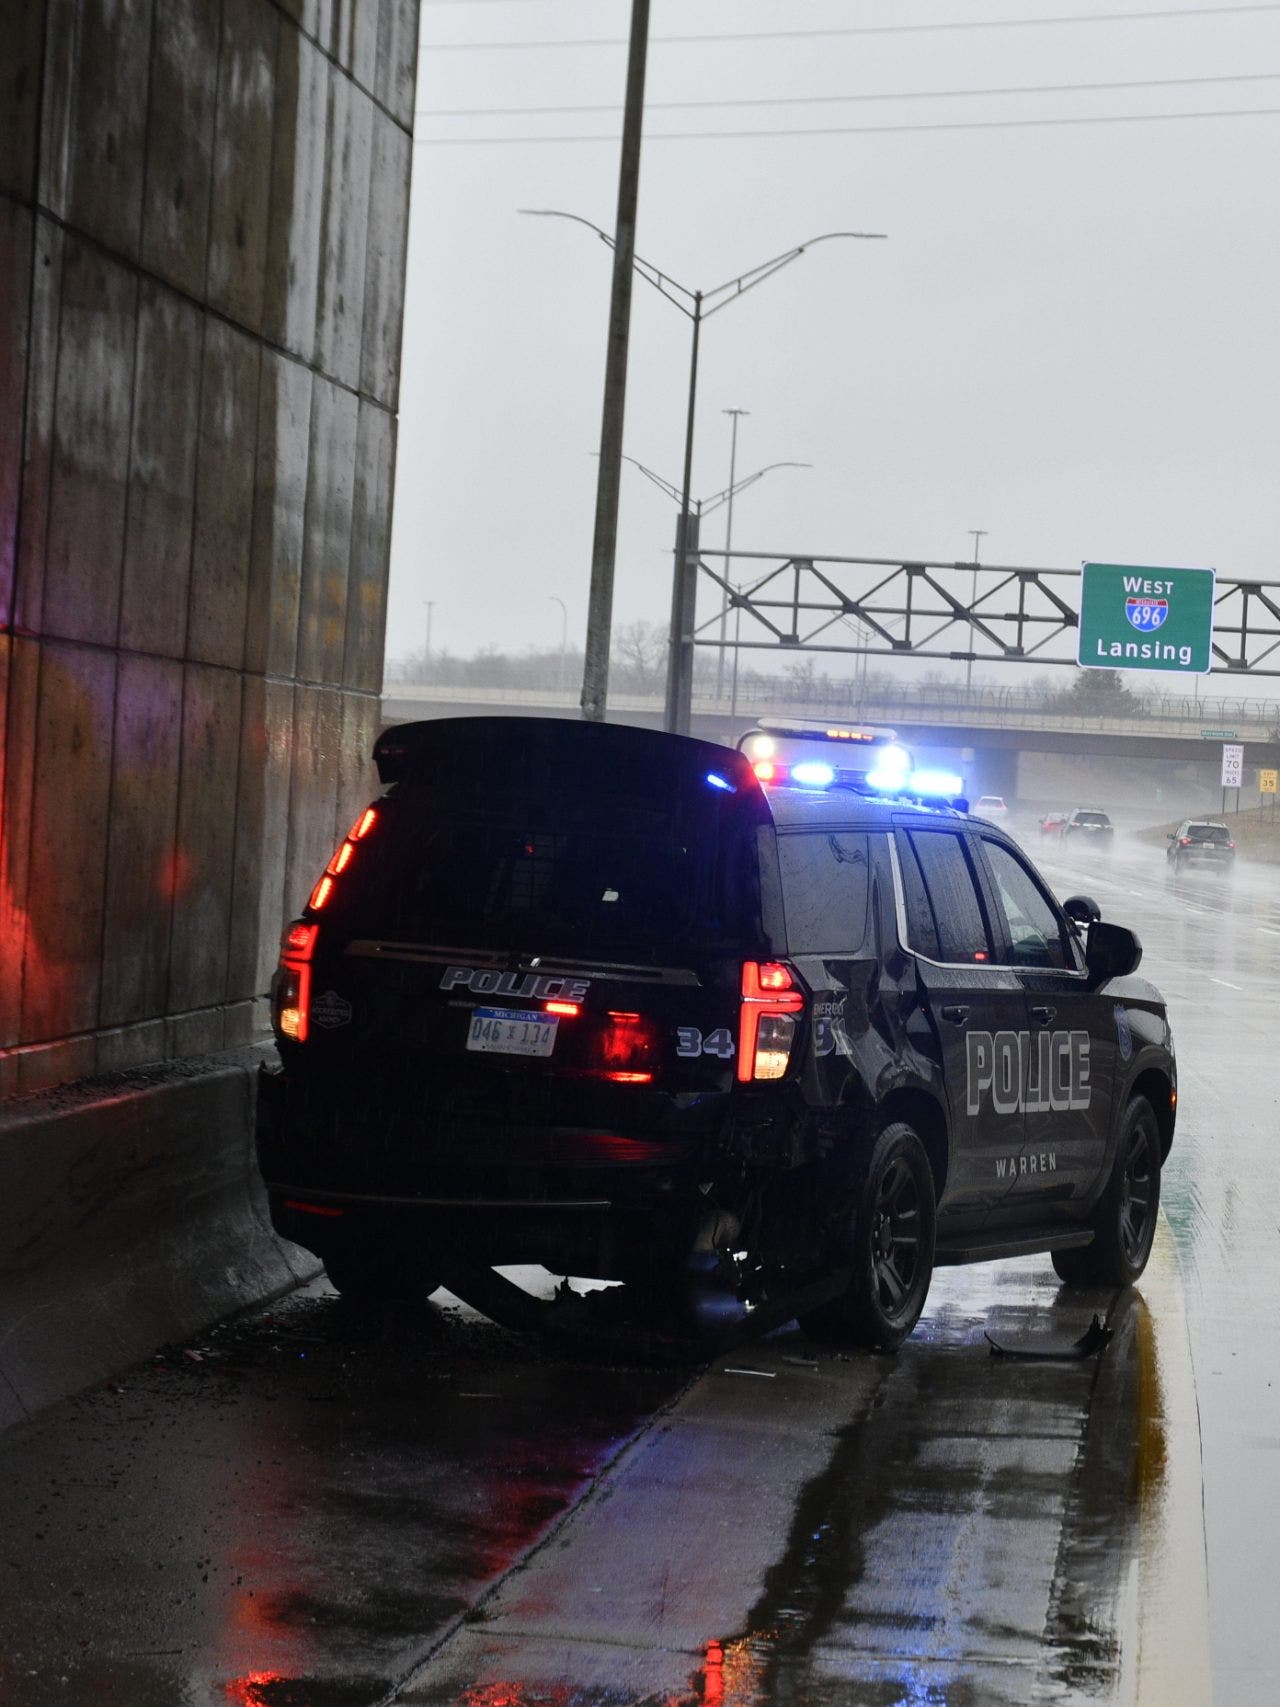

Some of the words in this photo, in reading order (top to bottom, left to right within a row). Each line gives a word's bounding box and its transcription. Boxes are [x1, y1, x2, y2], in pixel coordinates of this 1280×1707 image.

[1122, 576, 1174, 595] WEST
[1132, 606, 1160, 626] 696
[1097, 638, 1192, 666] Lansing
[1226, 760, 1240, 769] 70
[1226, 776, 1237, 784] 65
[1262, 779, 1274, 787] 35
[439, 966, 591, 1003] POLICE
[493, 1010, 538, 1021] MICHIGAN
[676, 1026, 736, 1059] 34
[966, 1030, 1092, 1116] POLICE
[996, 1153, 1057, 1178] WARREN
